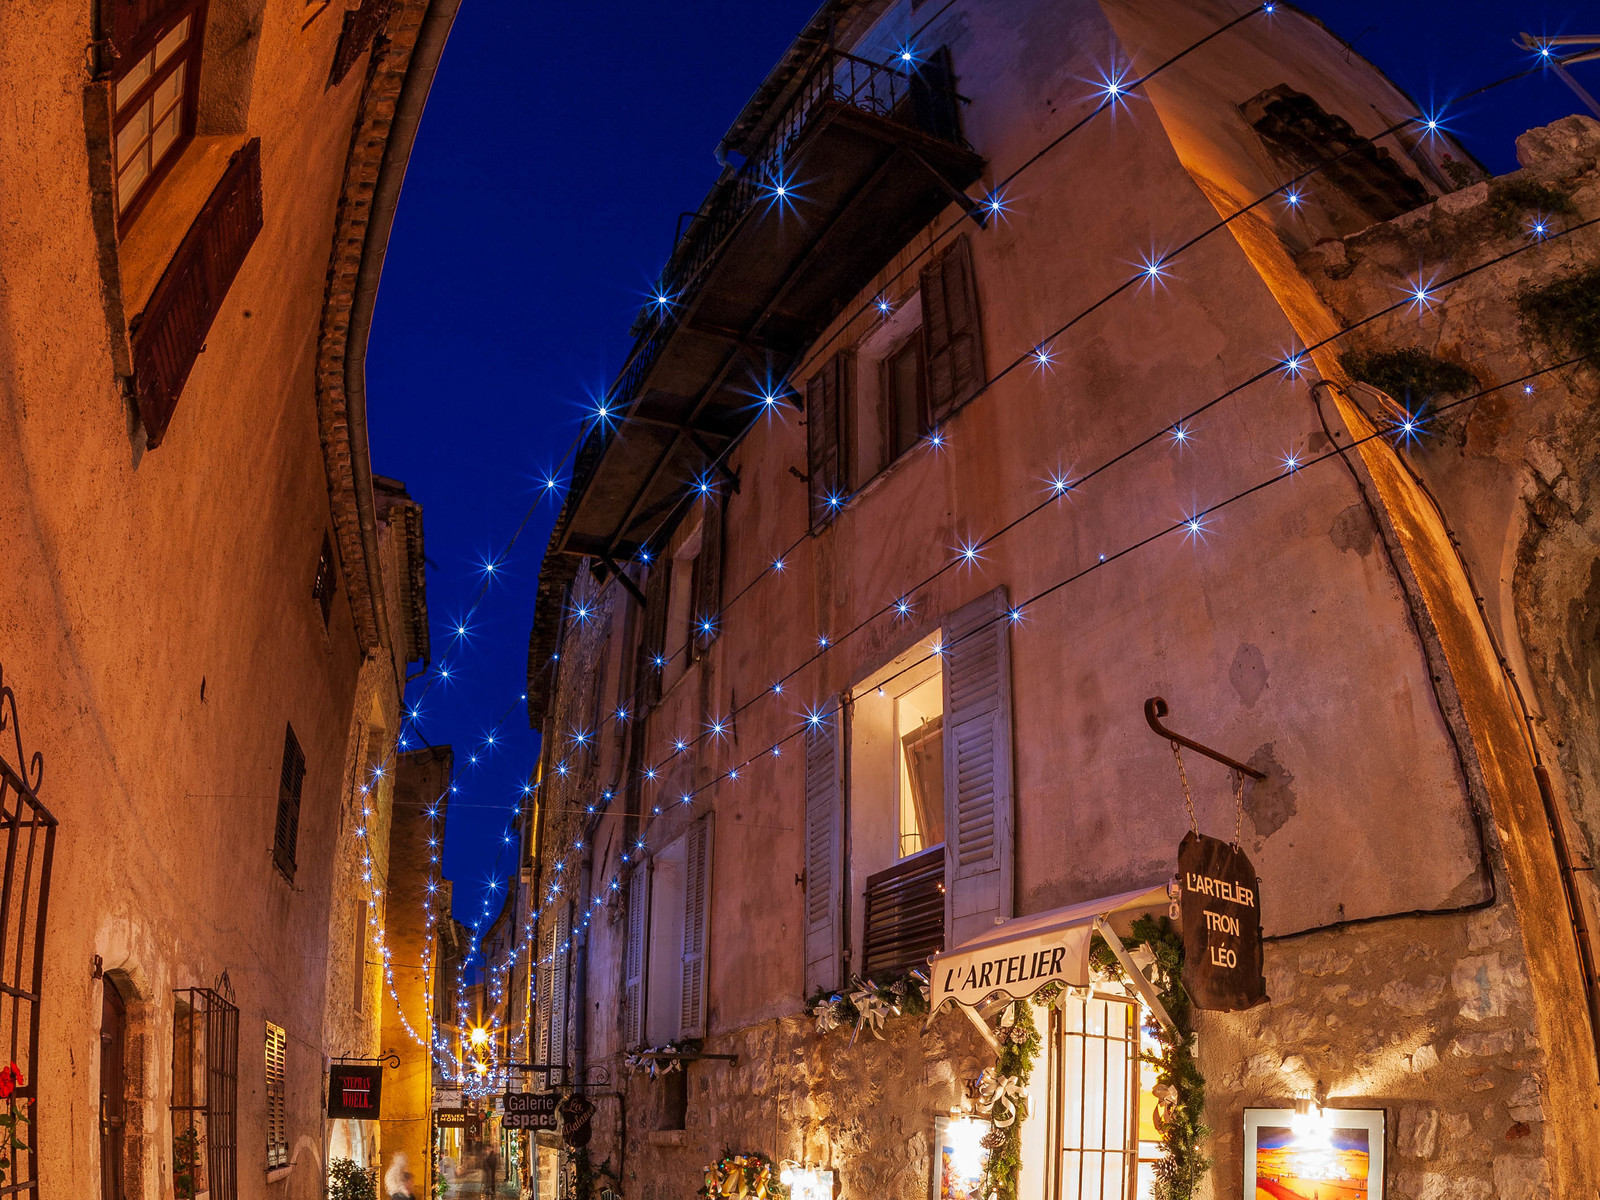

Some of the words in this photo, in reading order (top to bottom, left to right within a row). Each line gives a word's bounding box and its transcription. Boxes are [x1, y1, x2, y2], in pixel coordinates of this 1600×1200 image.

[1203, 910, 1240, 937] TRON
[1210, 942, 1237, 969] LÉO
[508, 1095, 554, 1111] Galerie
[503, 1112, 557, 1129] Espace
